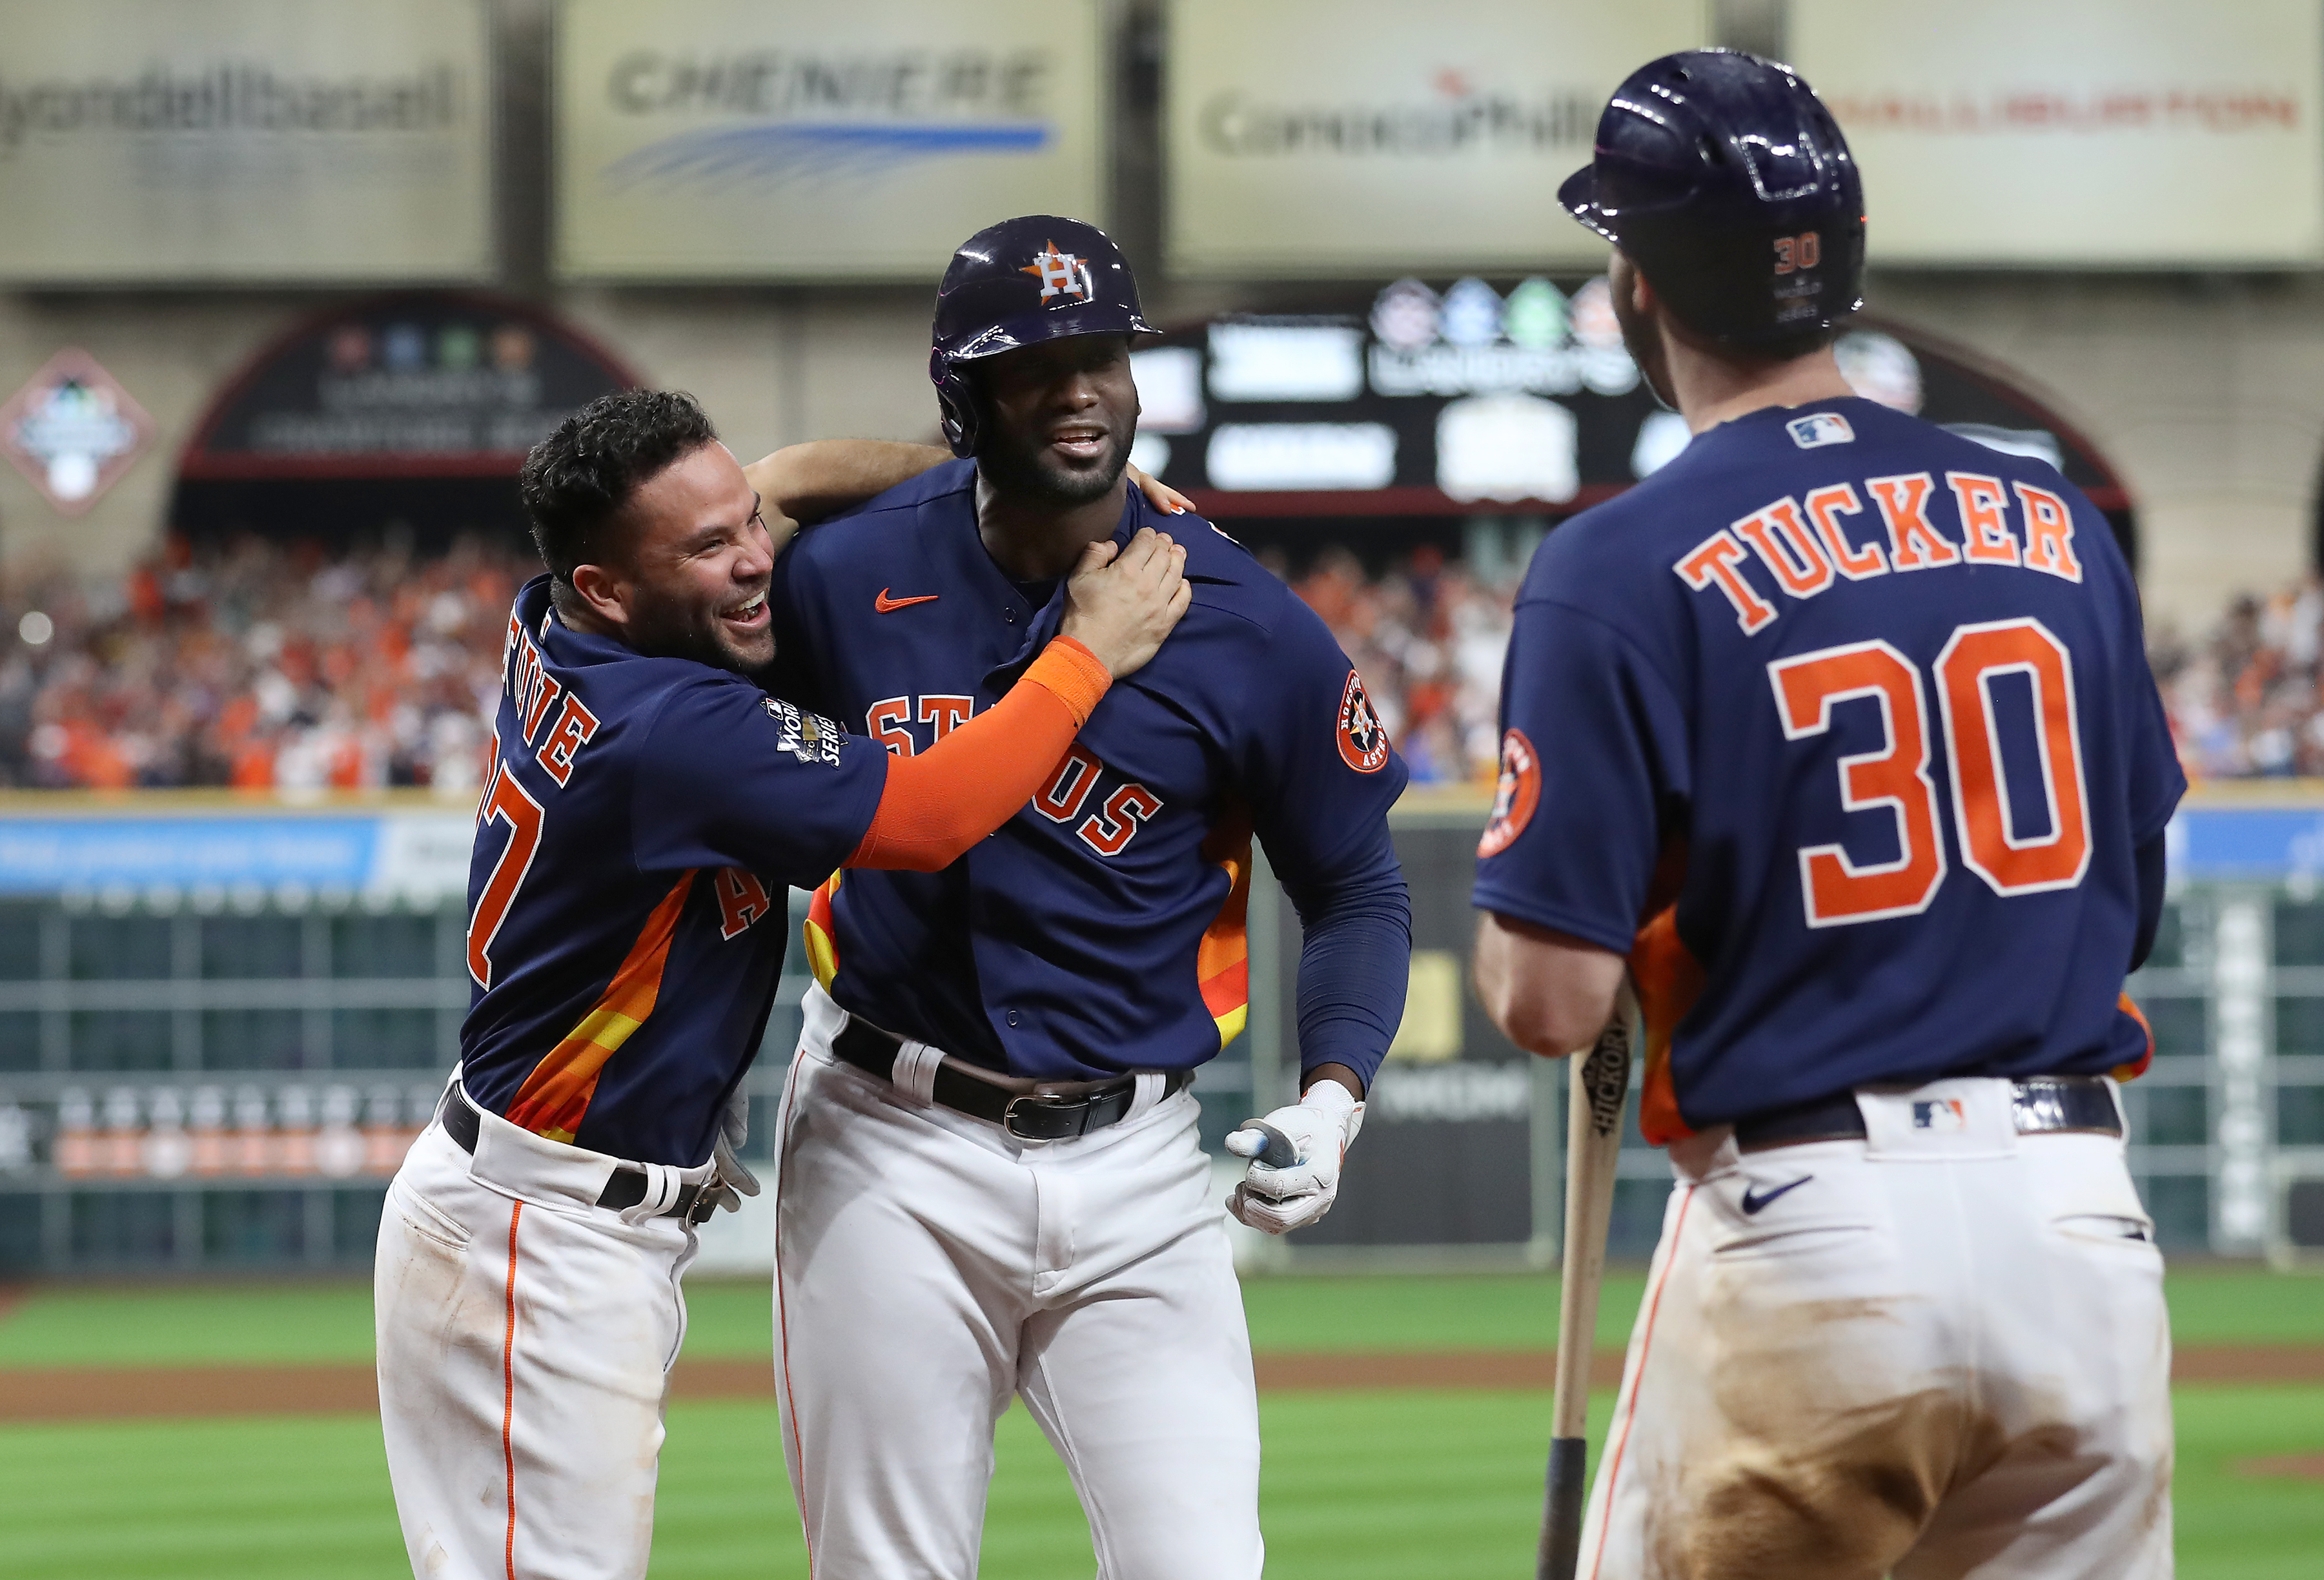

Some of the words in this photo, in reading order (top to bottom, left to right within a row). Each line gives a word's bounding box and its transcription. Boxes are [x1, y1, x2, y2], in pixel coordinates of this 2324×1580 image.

[607, 48, 1054, 115] CHENIERE
[1773, 232, 1820, 275] 30
[1673, 471, 2083, 637] TUCKER
[1766, 617, 2093, 929] 30
